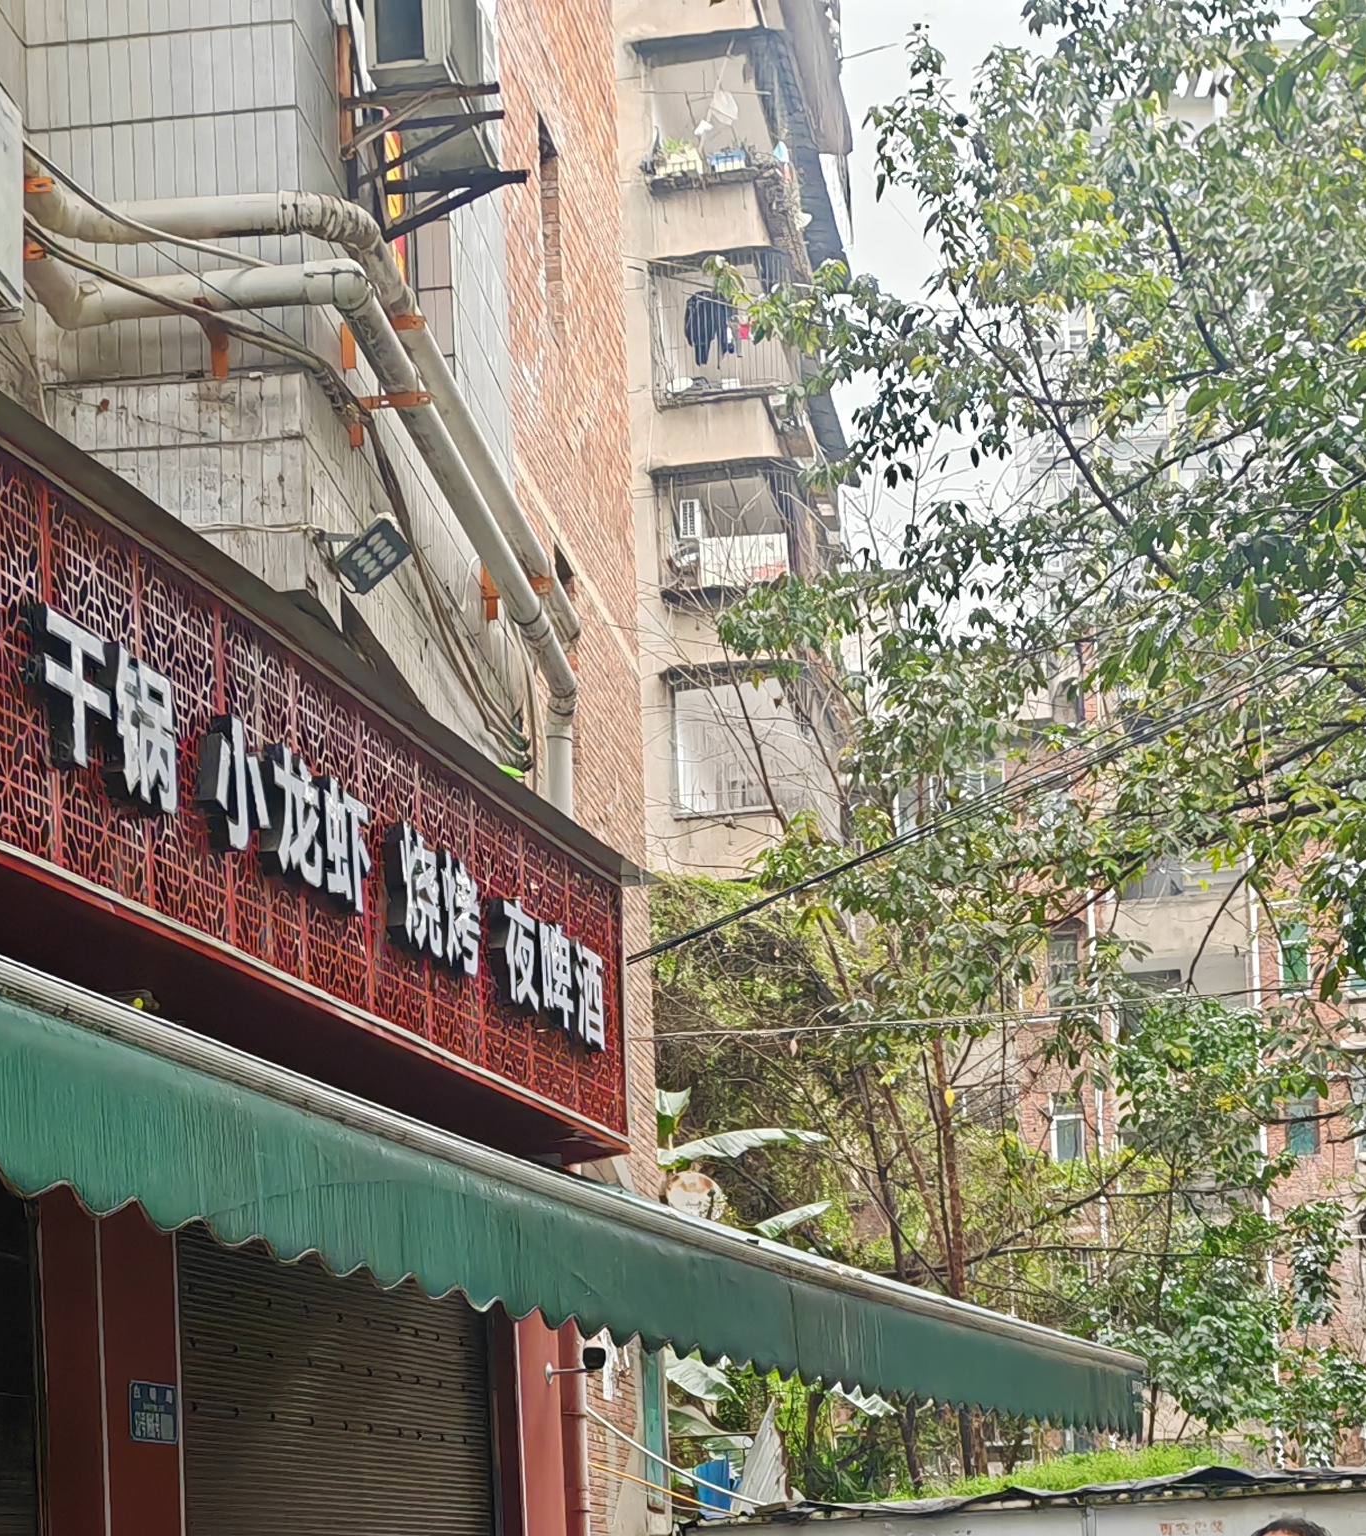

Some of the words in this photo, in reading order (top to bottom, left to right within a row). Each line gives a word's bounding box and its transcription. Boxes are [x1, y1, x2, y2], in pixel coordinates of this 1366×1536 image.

[43, 604, 178, 814] 干锅
[215, 716, 371, 914] 小龙虾
[399, 820, 482, 977] 烧烤
[503, 896, 606, 1052] 夜啤酒
